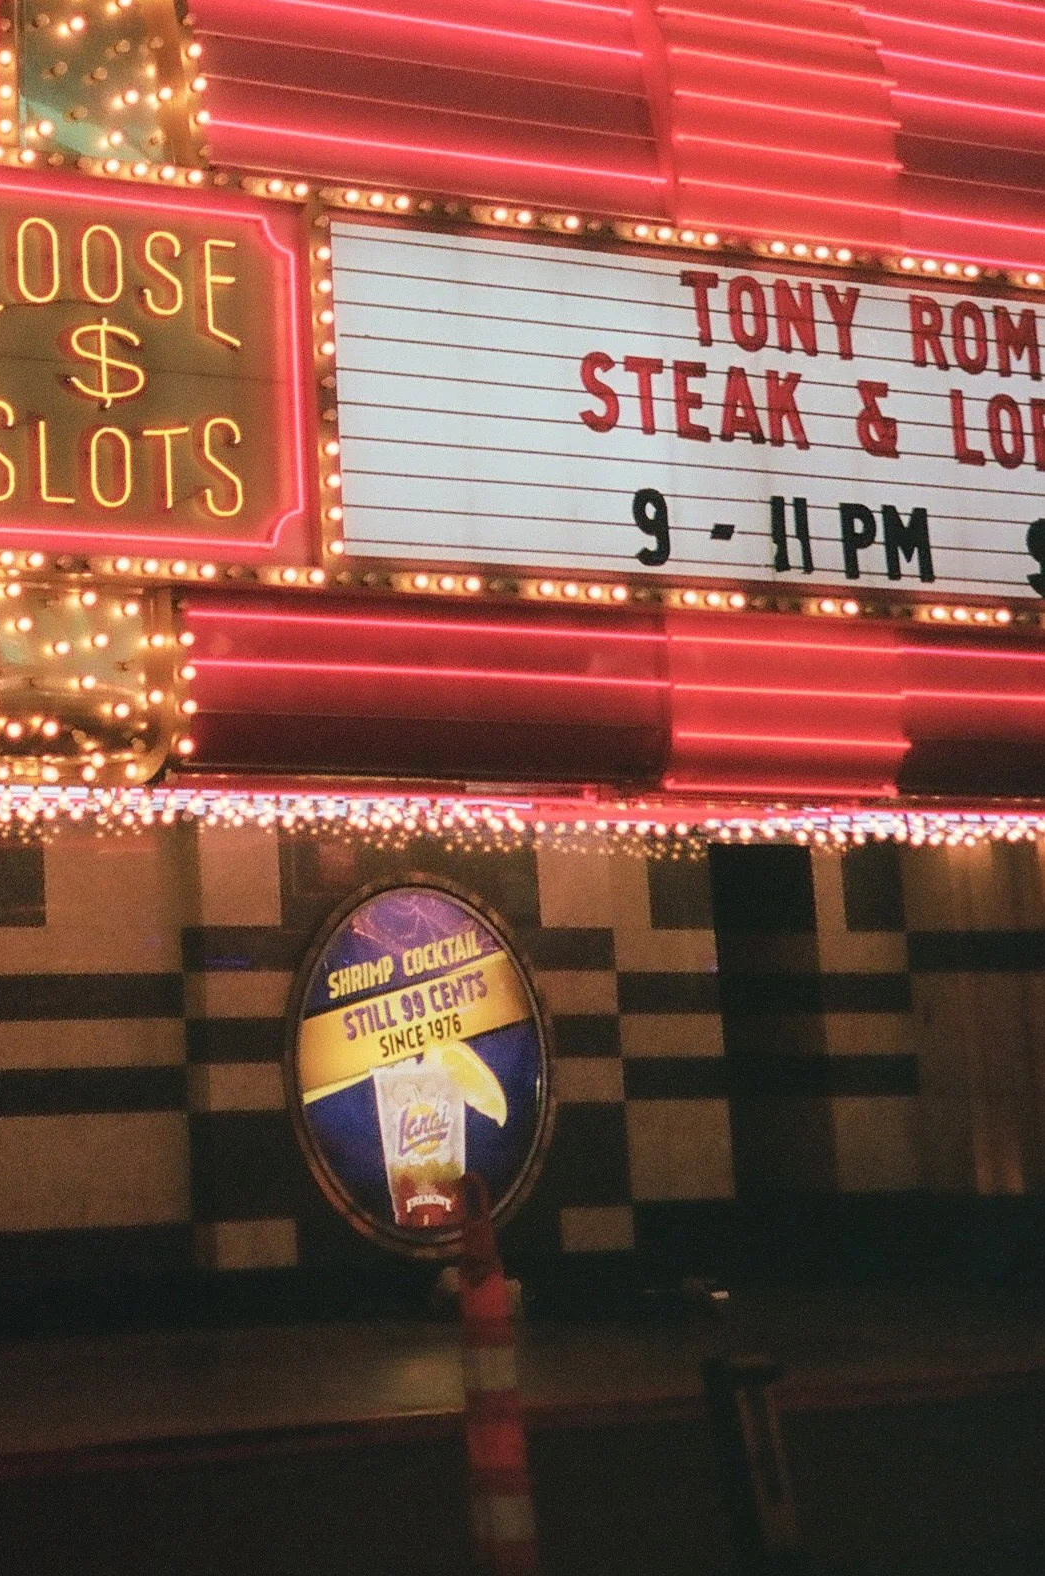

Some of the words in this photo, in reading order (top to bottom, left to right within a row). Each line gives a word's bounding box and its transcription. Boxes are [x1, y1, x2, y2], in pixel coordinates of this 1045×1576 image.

[680, 270, 860, 361] TONY
[69, 317, 145, 408] $
[578, 350, 811, 450] STEAK
[857, 380, 900, 459] &
[632, 488, 671, 567] 9
[327, 955, 394, 1000] SHRIMP
[402, 930, 483, 977] COCKTAIL
[342, 1001, 397, 1041] STILL
[401, 989, 427, 1024] 99
[430, 971, 488, 1017] CENTS
[379, 1025, 426, 1058] SINCE
[427, 1012, 463, 1049] 1976
